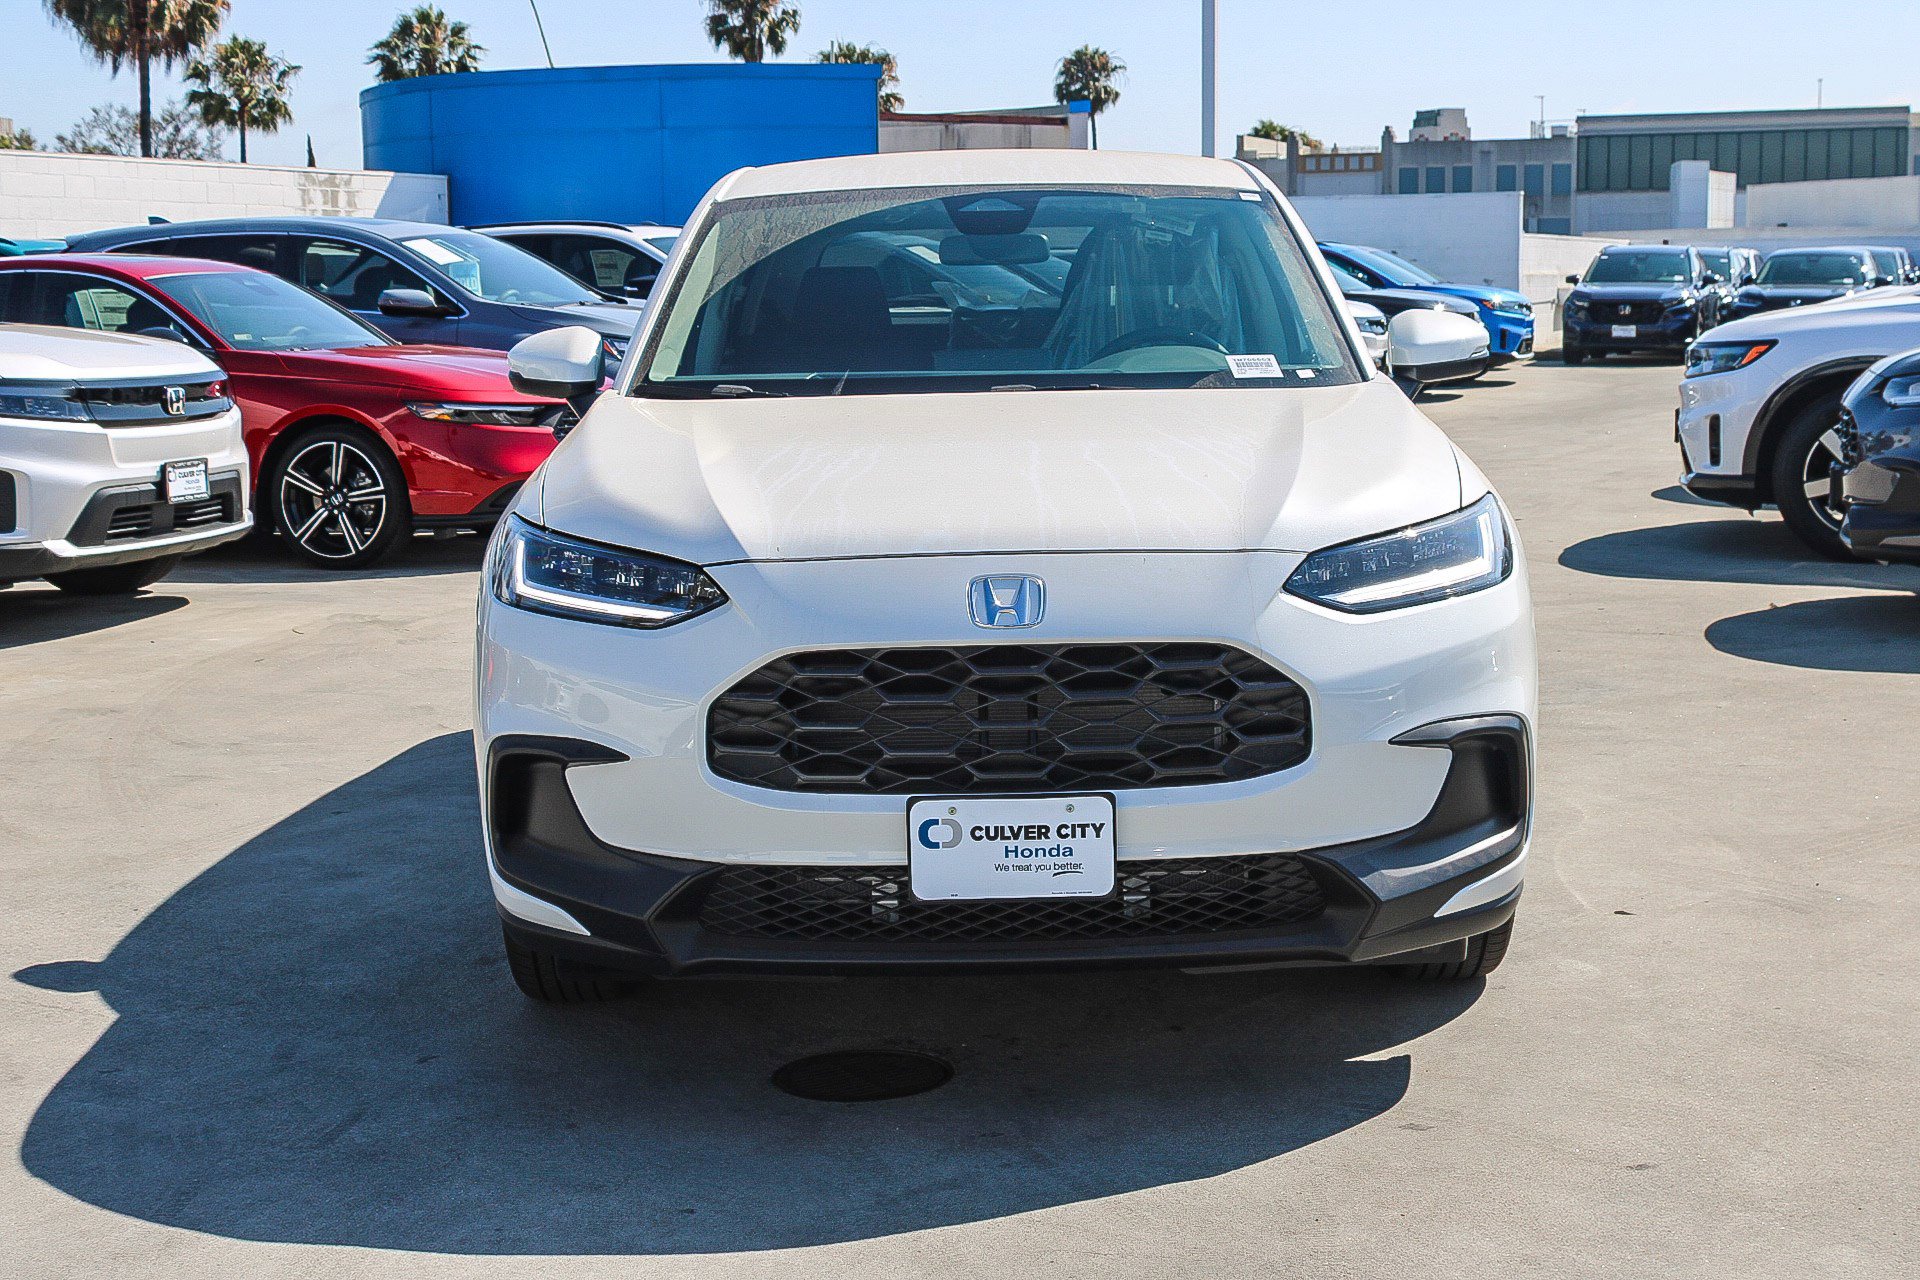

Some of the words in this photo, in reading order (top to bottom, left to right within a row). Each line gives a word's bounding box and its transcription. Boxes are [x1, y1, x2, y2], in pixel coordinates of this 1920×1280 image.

[969, 824, 1051, 842] CULVER
[1056, 822, 1106, 840] CITY
[1004, 844, 1074, 859] Honda
[994, 863, 1010, 872] We
[1012, 863, 1033, 872] treat
[1034, 864, 1052, 873] you
[1053, 862, 1085, 871] better.
